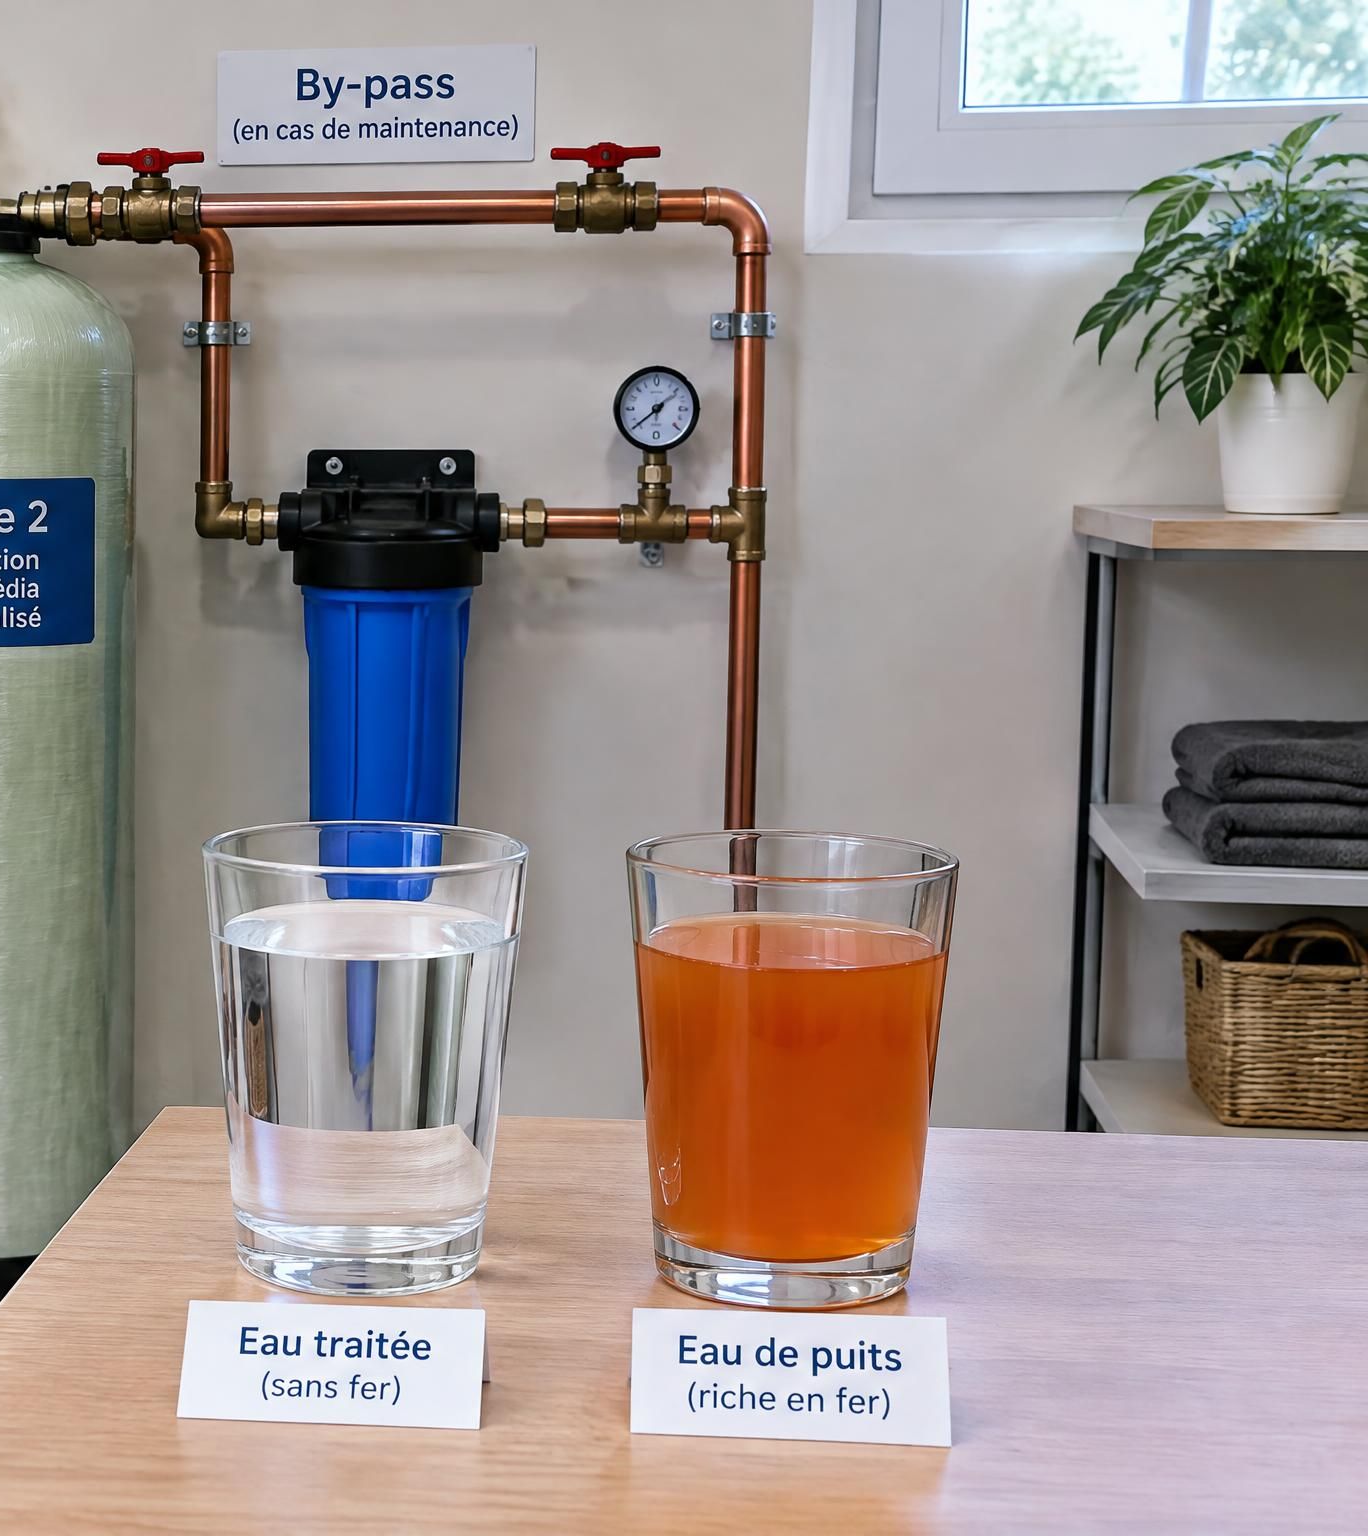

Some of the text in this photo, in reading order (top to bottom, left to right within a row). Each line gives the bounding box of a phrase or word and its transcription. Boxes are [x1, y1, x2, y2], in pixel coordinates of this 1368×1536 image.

[296, 68, 454, 109] By-pass
[233, 113, 518, 144] (en cas de maintenance)
[28, 499, 47, 532] 2
[239, 1326, 431, 1360] Eau traitée
[678, 1334, 901, 1376] Eau de puits
[261, 1370, 400, 1405] (sans fer)
[688, 1381, 889, 1420] (riche en fer)
